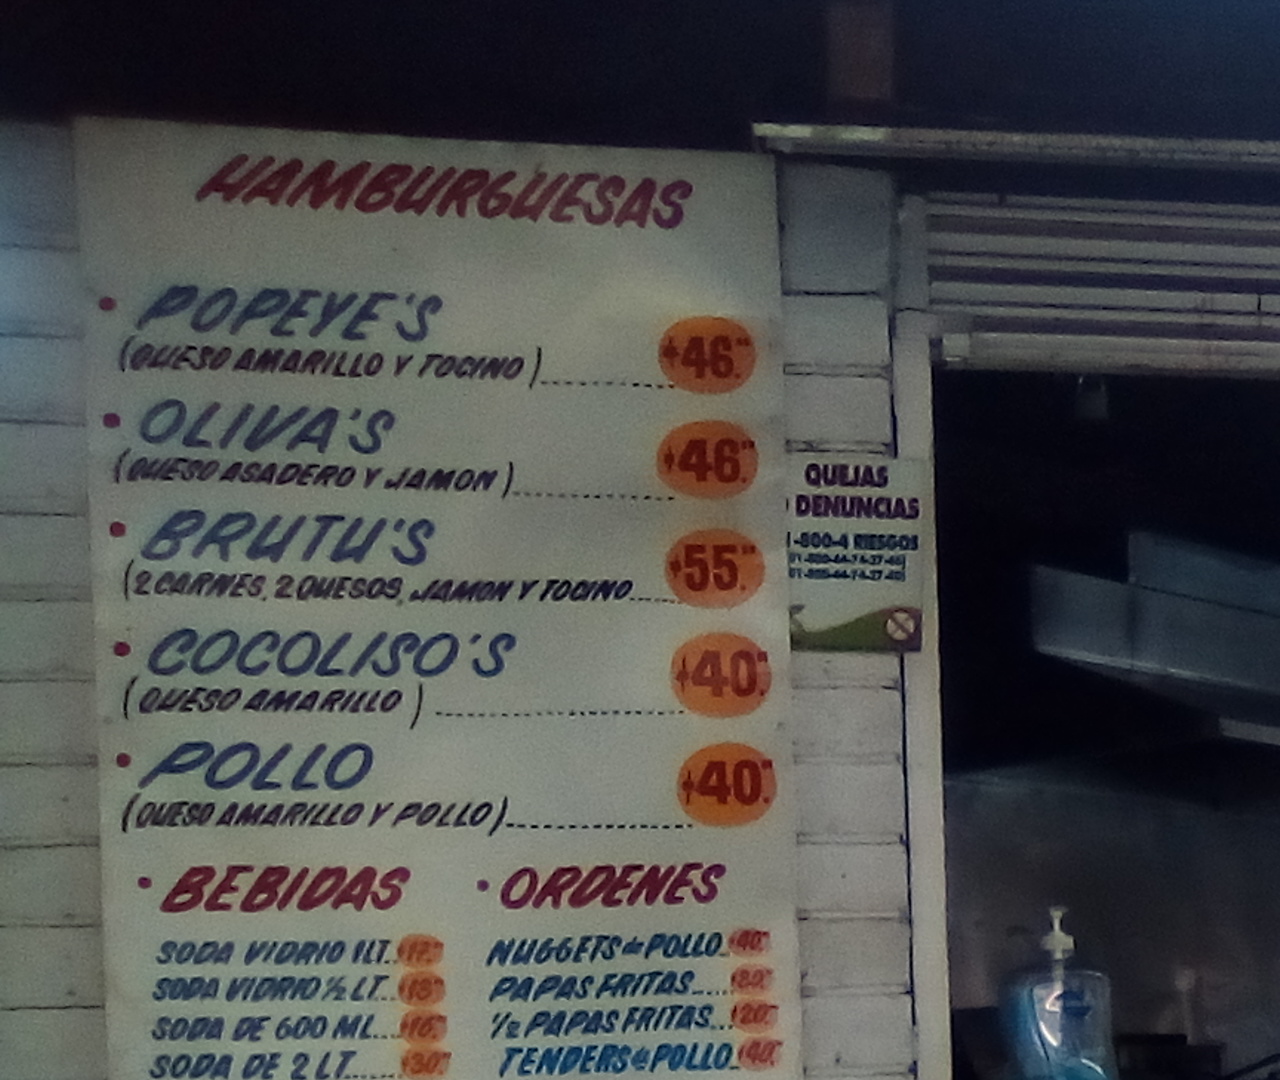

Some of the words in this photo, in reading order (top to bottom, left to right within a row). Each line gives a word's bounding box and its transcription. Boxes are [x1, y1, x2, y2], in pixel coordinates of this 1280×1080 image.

[196, 154, 694, 230] HAMBURGUESAS
[137, 286, 442, 341] POPEYE'S
[233, 347, 384, 378] AMARILLO
[393, 354, 413, 378] Y
[139, 399, 395, 454] OLIVA'S
[219, 462, 355, 487] ASADERO
[362, 467, 382, 488] Y
[804, 463, 889, 488] QUEJAS
[796, 494, 919, 520] DENUNCIAS
[140, 509, 435, 565] BRUTU'S
[275, 574, 296, 597] 2
[409, 579, 512, 602] JAMON
[518, 580, 540, 600] Y
[540, 581, 633, 600] TOCINO
[147, 629, 516, 678] COCOLISO'S
[138, 741, 373, 790] POLLO
[215, 802, 365, 827] AMARILLO
[369, 802, 394, 828] Y
[160, 865, 412, 913] BEBIDAS
[499, 863, 727, 910] ORDENES
[155, 940, 235, 965] SODA
[243, 940, 346, 965] VIDRIO
[485, 934, 622, 967] NUGGETS
[645, 932, 723, 959] POLLO
[152, 976, 219, 1002] SODA
[225, 976, 321, 1002] VIDRIO
[489, 974, 594, 1002] PAPAS
[596, 970, 695, 998] FRITAS
[151, 1016, 225, 1041] SODA
[231, 1016, 271, 1041] DE
[275, 1015, 328, 1040] 600
[524, 1009, 619, 1038] PAPAS
[621, 1003, 714, 1033] FRITAS
[149, 1053, 234, 1080] SODA
[242, 1053, 282, 1080] DE
[290, 1052, 310, 1080] 2
[499, 1044, 631, 1078] TENDERS
[650, 1042, 733, 1073] POLLO
